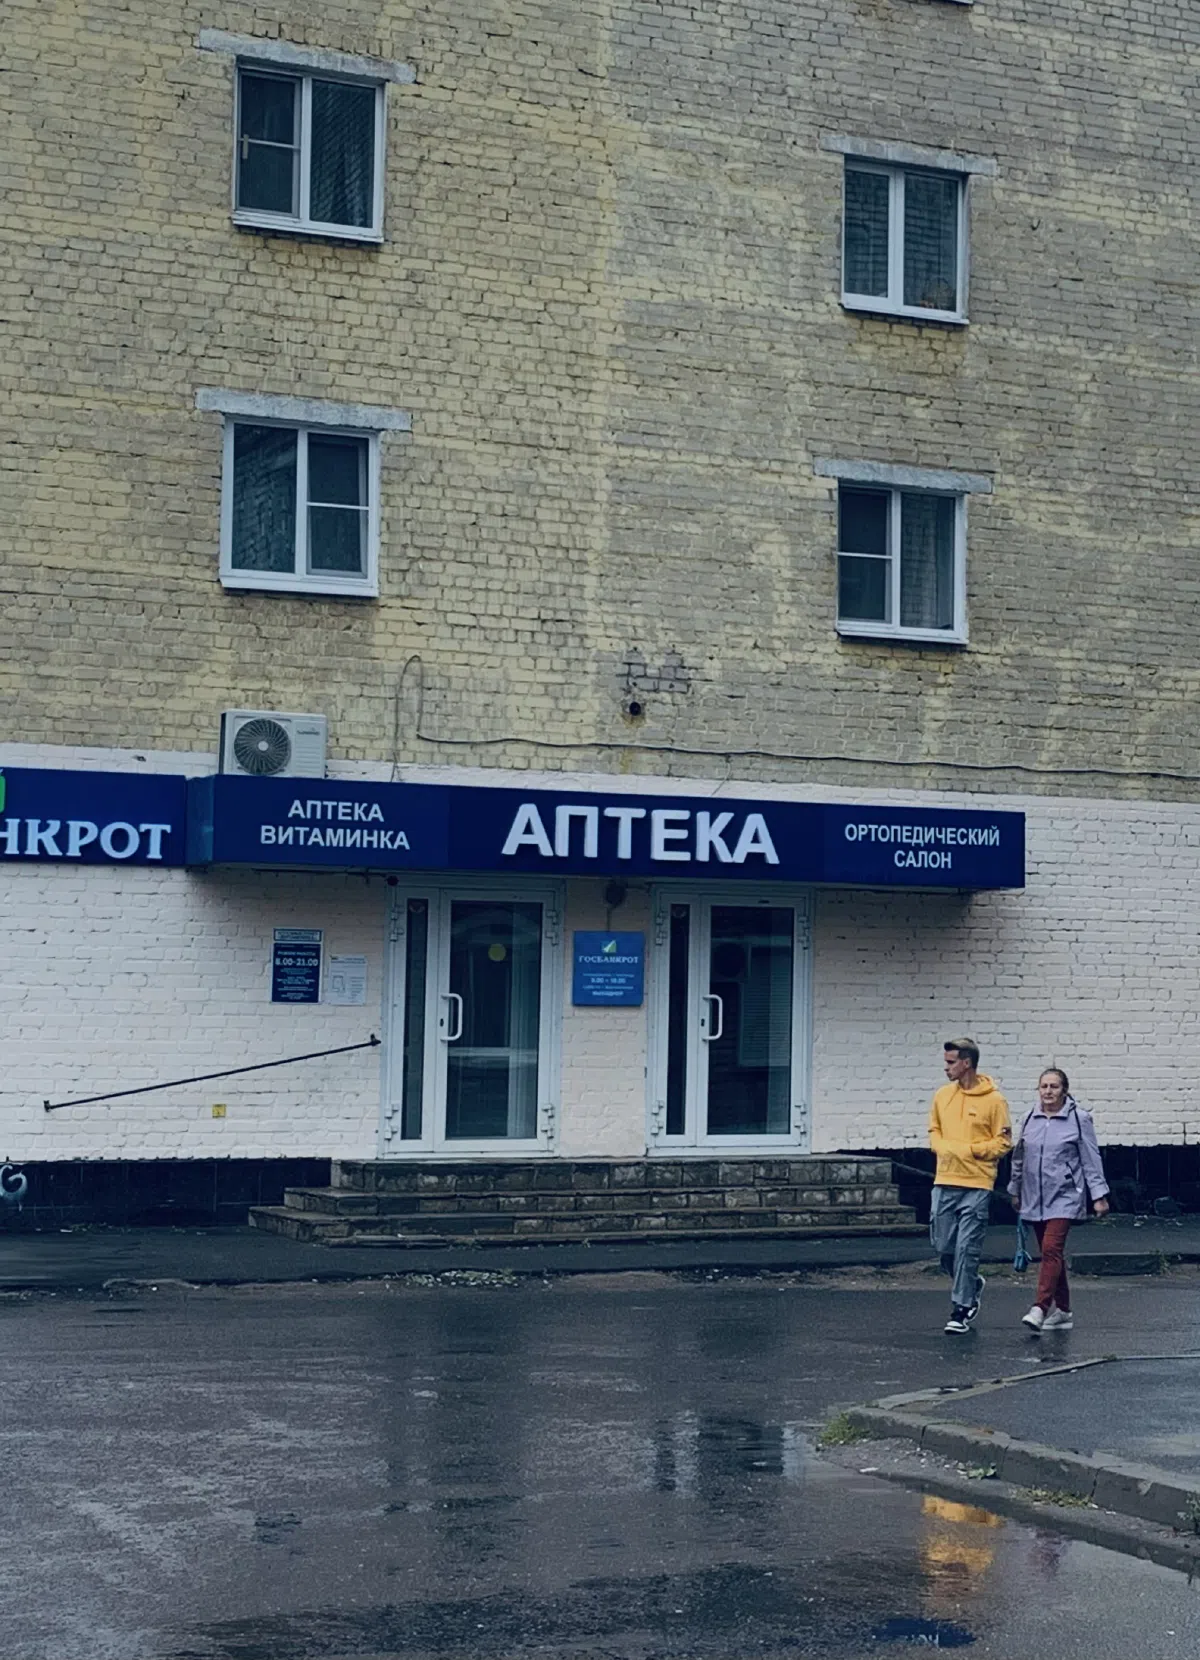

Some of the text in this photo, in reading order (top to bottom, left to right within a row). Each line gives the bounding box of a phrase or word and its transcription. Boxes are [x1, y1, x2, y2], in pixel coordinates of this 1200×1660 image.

[287, 799, 385, 823] АПТЕКА
[260, 825, 411, 851] ВИТАМИНКА
[502, 802, 780, 865] АПТЕКА
[844, 823, 1000, 848] ОРТОПЕДИЧЕСКИЙ
[893, 849, 953, 869] САЛОН
[578, 955, 639, 964] ГОСБАНКРОТ
